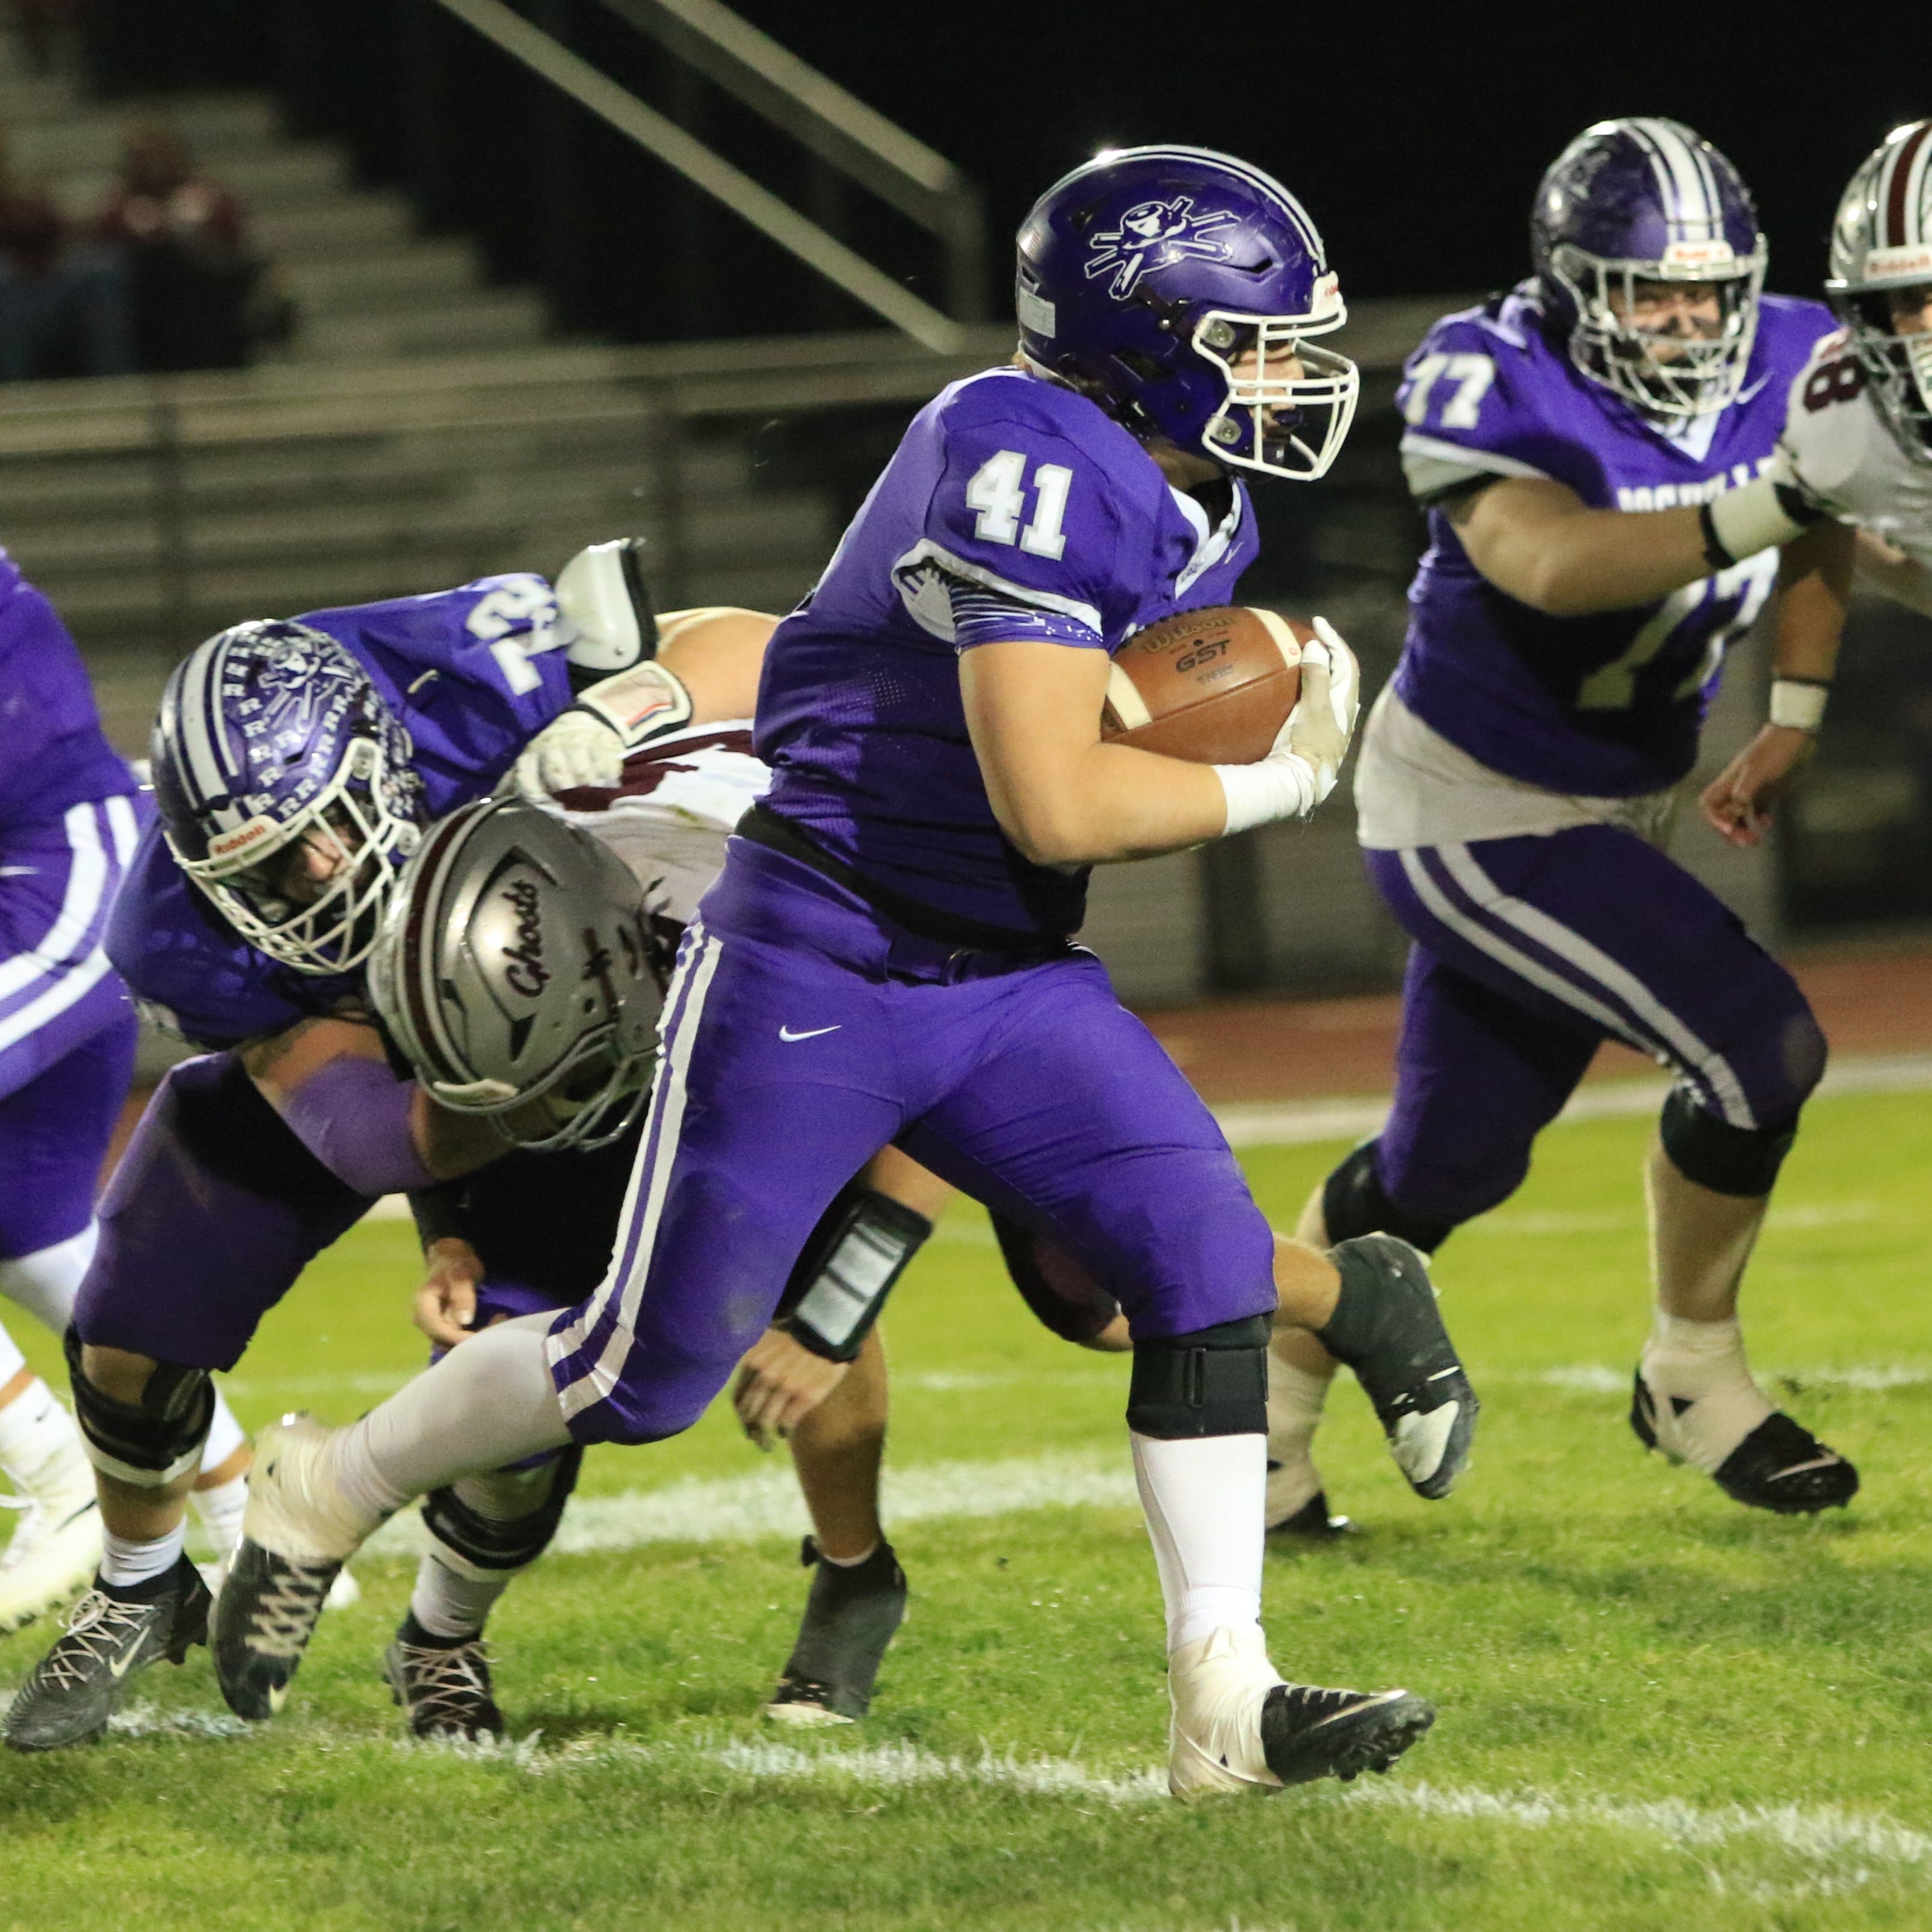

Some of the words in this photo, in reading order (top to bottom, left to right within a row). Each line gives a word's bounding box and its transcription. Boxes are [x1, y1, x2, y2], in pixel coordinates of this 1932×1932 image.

[1405, 353, 1495, 430] 77
[966, 449, 1073, 561] 41
[1143, 617, 1236, 653] Wilson
[1176, 639, 1230, 673] GST
[501, 879, 551, 998] Ghosts
